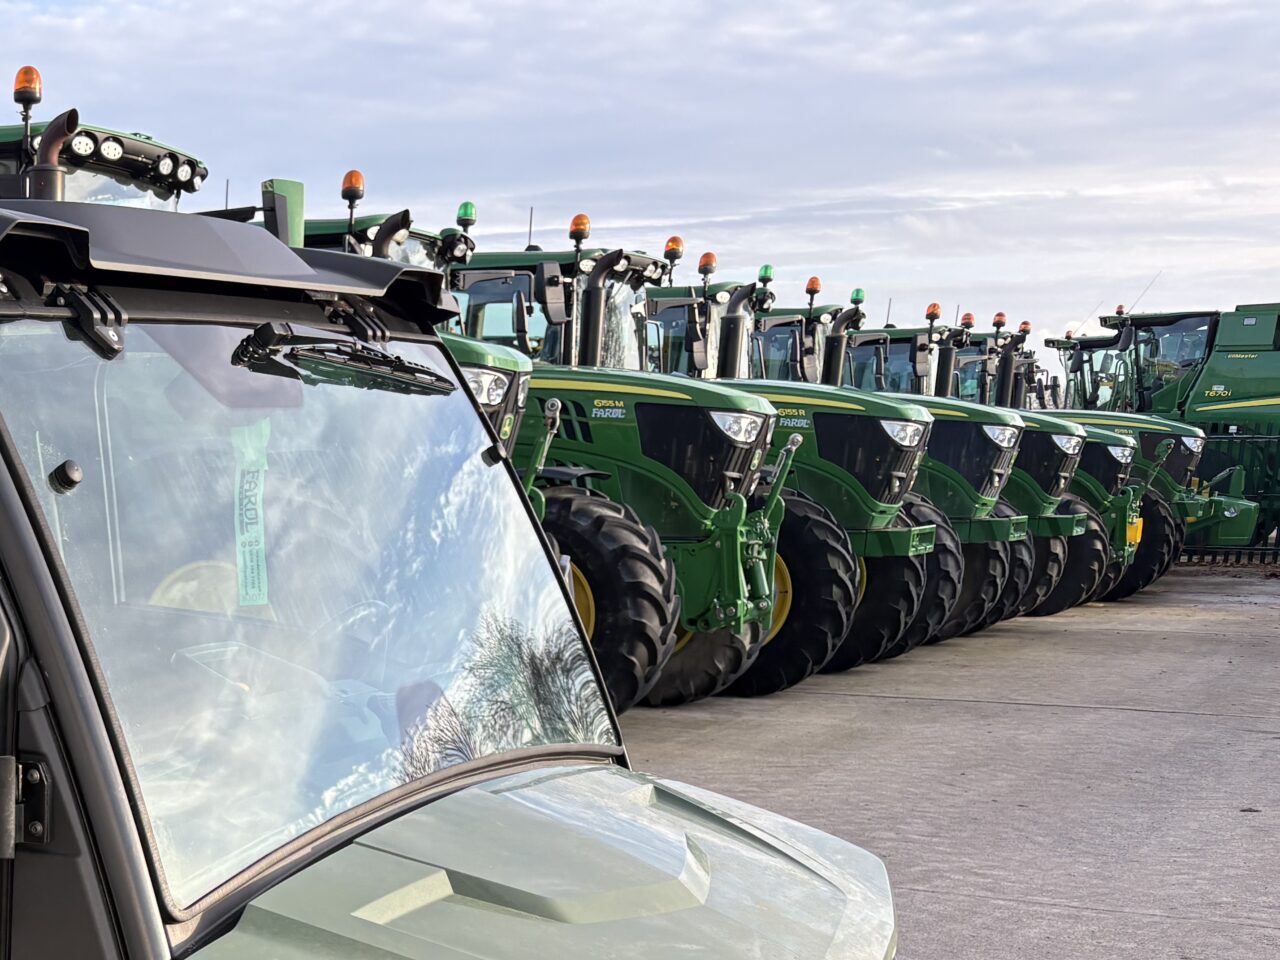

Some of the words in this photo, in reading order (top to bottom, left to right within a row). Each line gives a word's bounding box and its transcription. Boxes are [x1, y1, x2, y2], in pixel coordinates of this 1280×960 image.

[591, 408, 626, 419] FAROL
[779, 417, 811, 428] FAROL
[244, 468, 261, 534] FAROL
